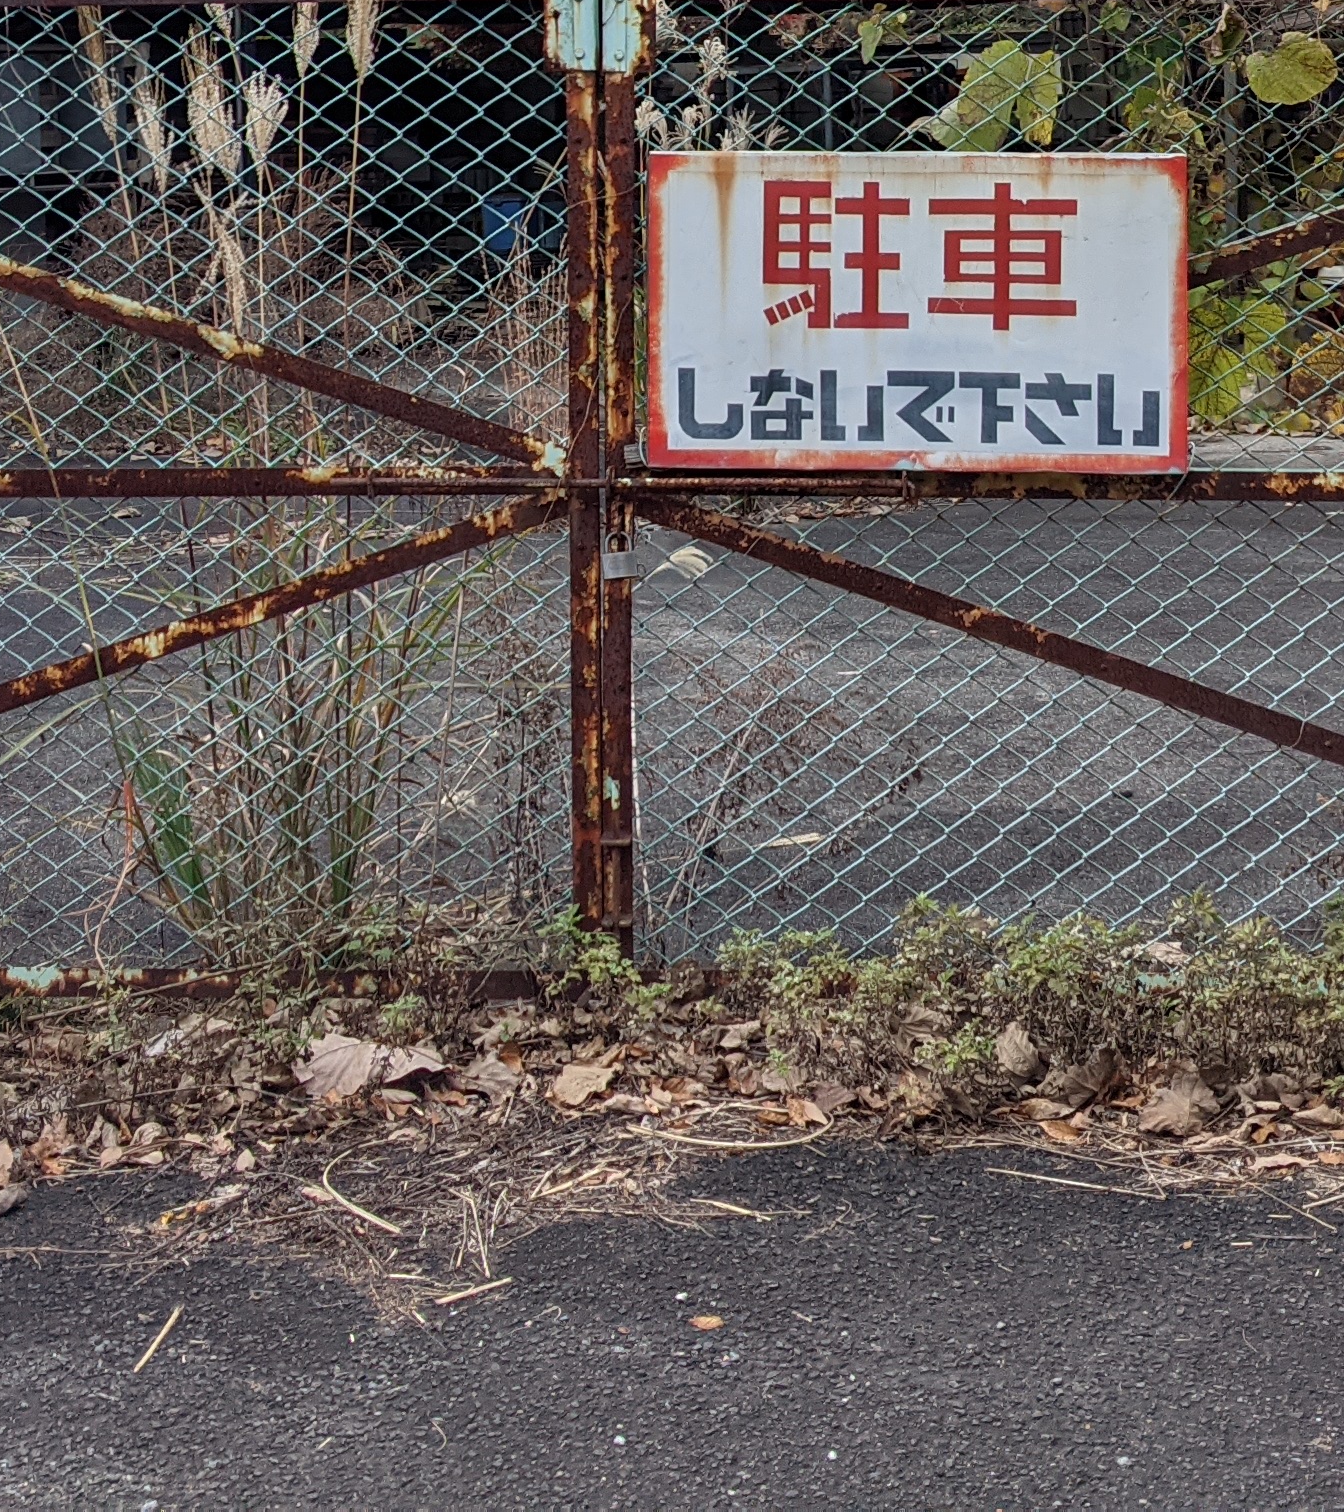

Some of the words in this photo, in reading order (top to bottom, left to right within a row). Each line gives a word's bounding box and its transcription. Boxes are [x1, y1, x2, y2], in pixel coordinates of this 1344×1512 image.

[763, 180, 1078, 331] 駐車
[677, 368, 1160, 447] しないで下さい
